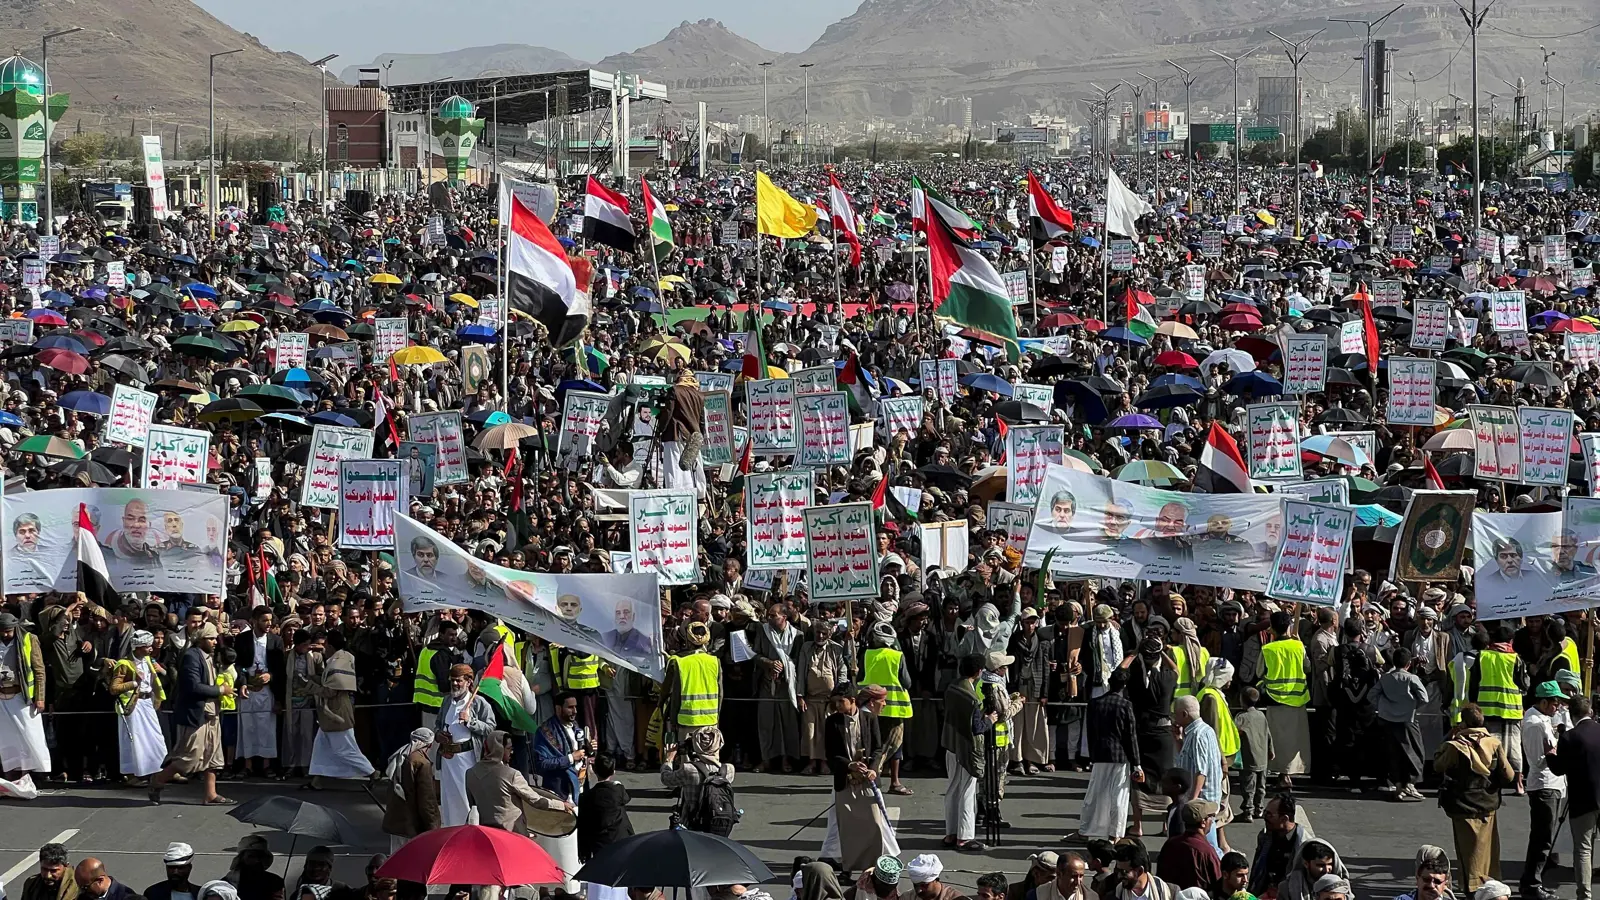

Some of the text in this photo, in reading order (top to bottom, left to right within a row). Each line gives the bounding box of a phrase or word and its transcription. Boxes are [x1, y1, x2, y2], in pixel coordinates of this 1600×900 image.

[1392, 361, 1432, 377] الله أكبر
[817, 373, 832, 383] الله
[751, 381, 792, 397] الله أكبر
[802, 397, 843, 413] الله أكبر
[1413, 408, 1431, 421] النصر
[1523, 412, 1568, 429] الله أكبر
[413, 416, 458, 434] الله أكبر
[318, 436, 367, 452] الله أكبر
[1016, 430, 1045, 447] أكبر
[1546, 432, 1567, 441] الموت
[150, 436, 203, 454] الله أكبر
[1545, 444, 1565, 454] الموت
[344, 466, 398, 484] قاطعوا
[1542, 467, 1564, 480] النصر
[753, 476, 809, 497] الله أكبر
[637, 498, 690, 522] الله أكبر
[753, 496, 808, 511] الموت لأمريكا
[811, 508, 868, 531] الله أكبر
[992, 513, 1028, 528] الله أكبر
[1289, 509, 1347, 530] الله أكبر
[637, 521, 690, 535] الموت لأمريكا
[754, 529, 775, 542] اليهود
[811, 528, 869, 543] الموت لأمريكا
[638, 538, 690, 552] الموت لإسرائيل
[1287, 530, 1344, 548] الموت لأمريكا
[754, 544, 783, 561] للإسلام
[845, 544, 871, 558] الموت
[1314, 553, 1340, 564] الموت
[813, 559, 872, 576] اللعنة على اليهود
[1279, 563, 1300, 575] اليهود
[1316, 567, 1337, 580] اللعنة
[814, 576, 845, 594] للإسلام
[847, 573, 873, 592] النصر
